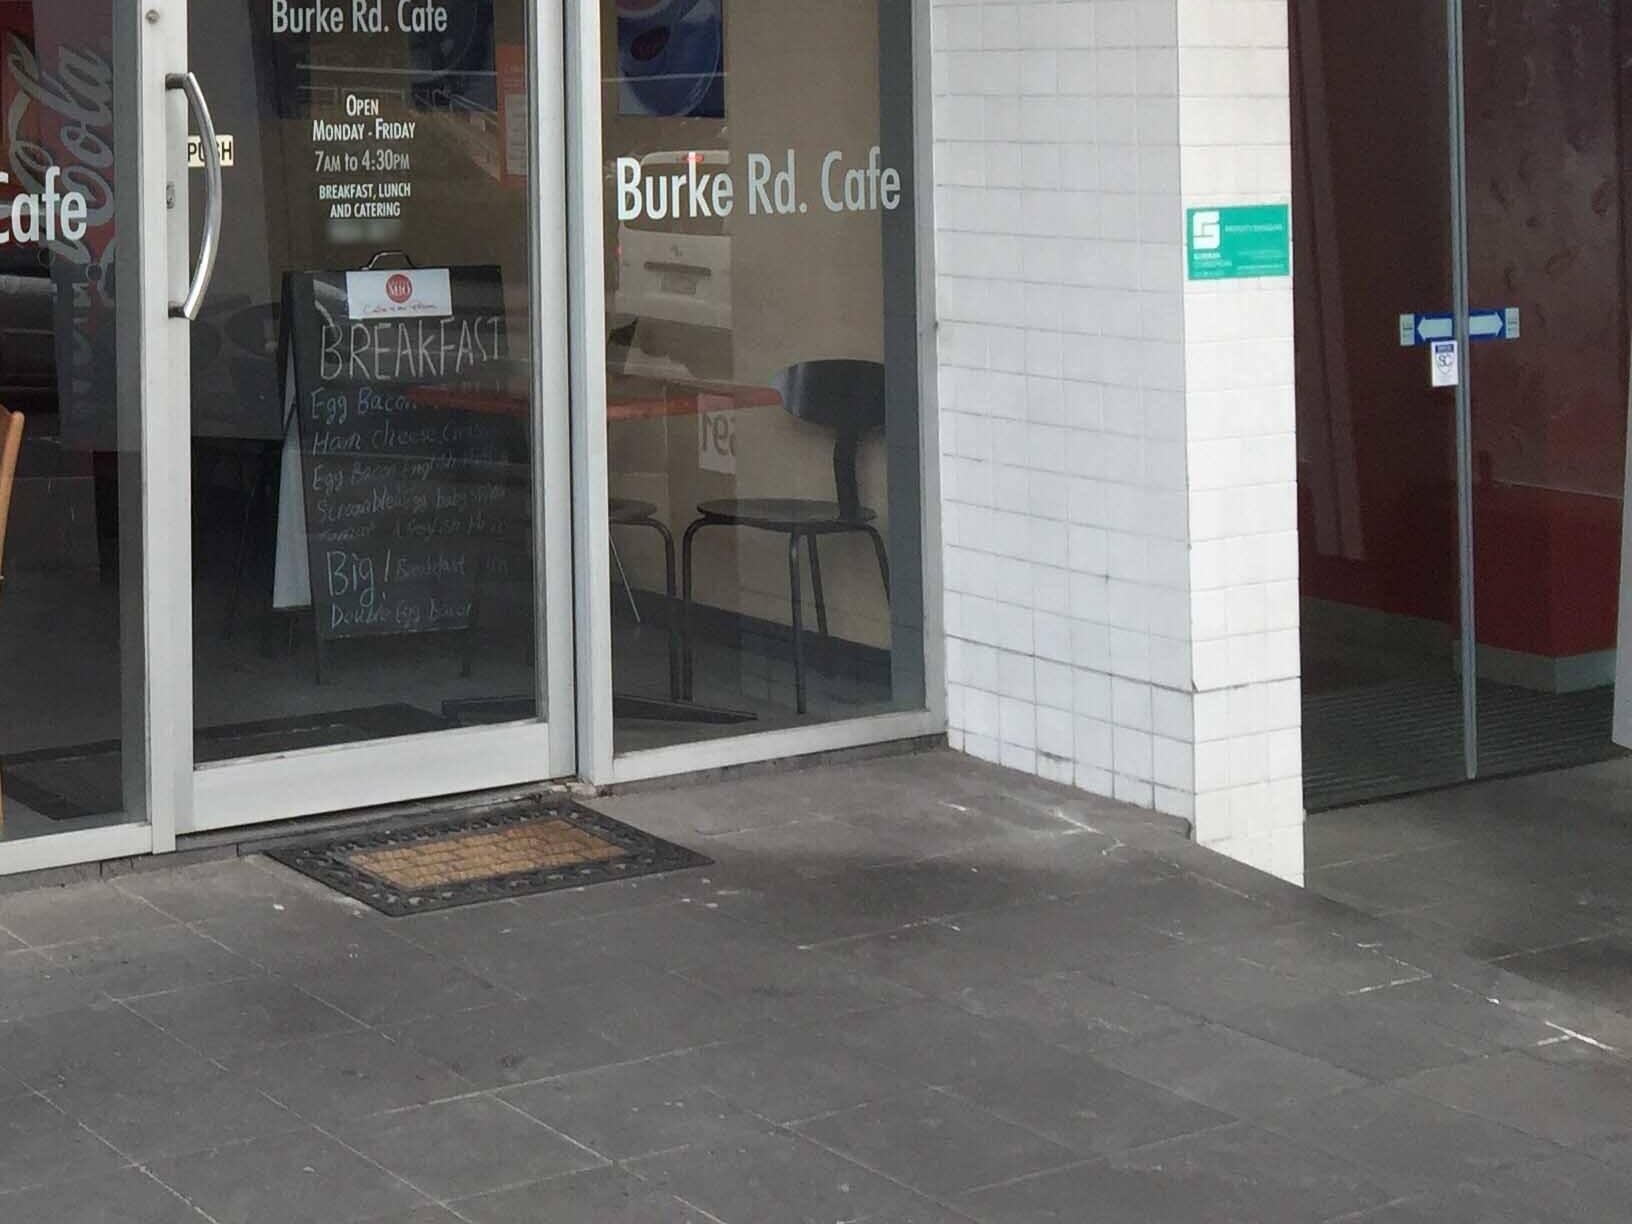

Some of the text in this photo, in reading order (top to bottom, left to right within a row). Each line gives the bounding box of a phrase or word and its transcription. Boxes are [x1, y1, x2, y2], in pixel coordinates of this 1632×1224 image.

[346, 95, 379, 117] OPEN
[312, 120, 364, 142] MONDAY
[375, 118, 416, 140] FRIDAY
[315, 150, 410, 173] 7AM to 4:30PM
[319, 181, 411, 201] BREAKFAST, LUNCH
[617, 146, 901, 221] Burke Rd. Cafe
[330, 201, 400, 218] AND CATERING
